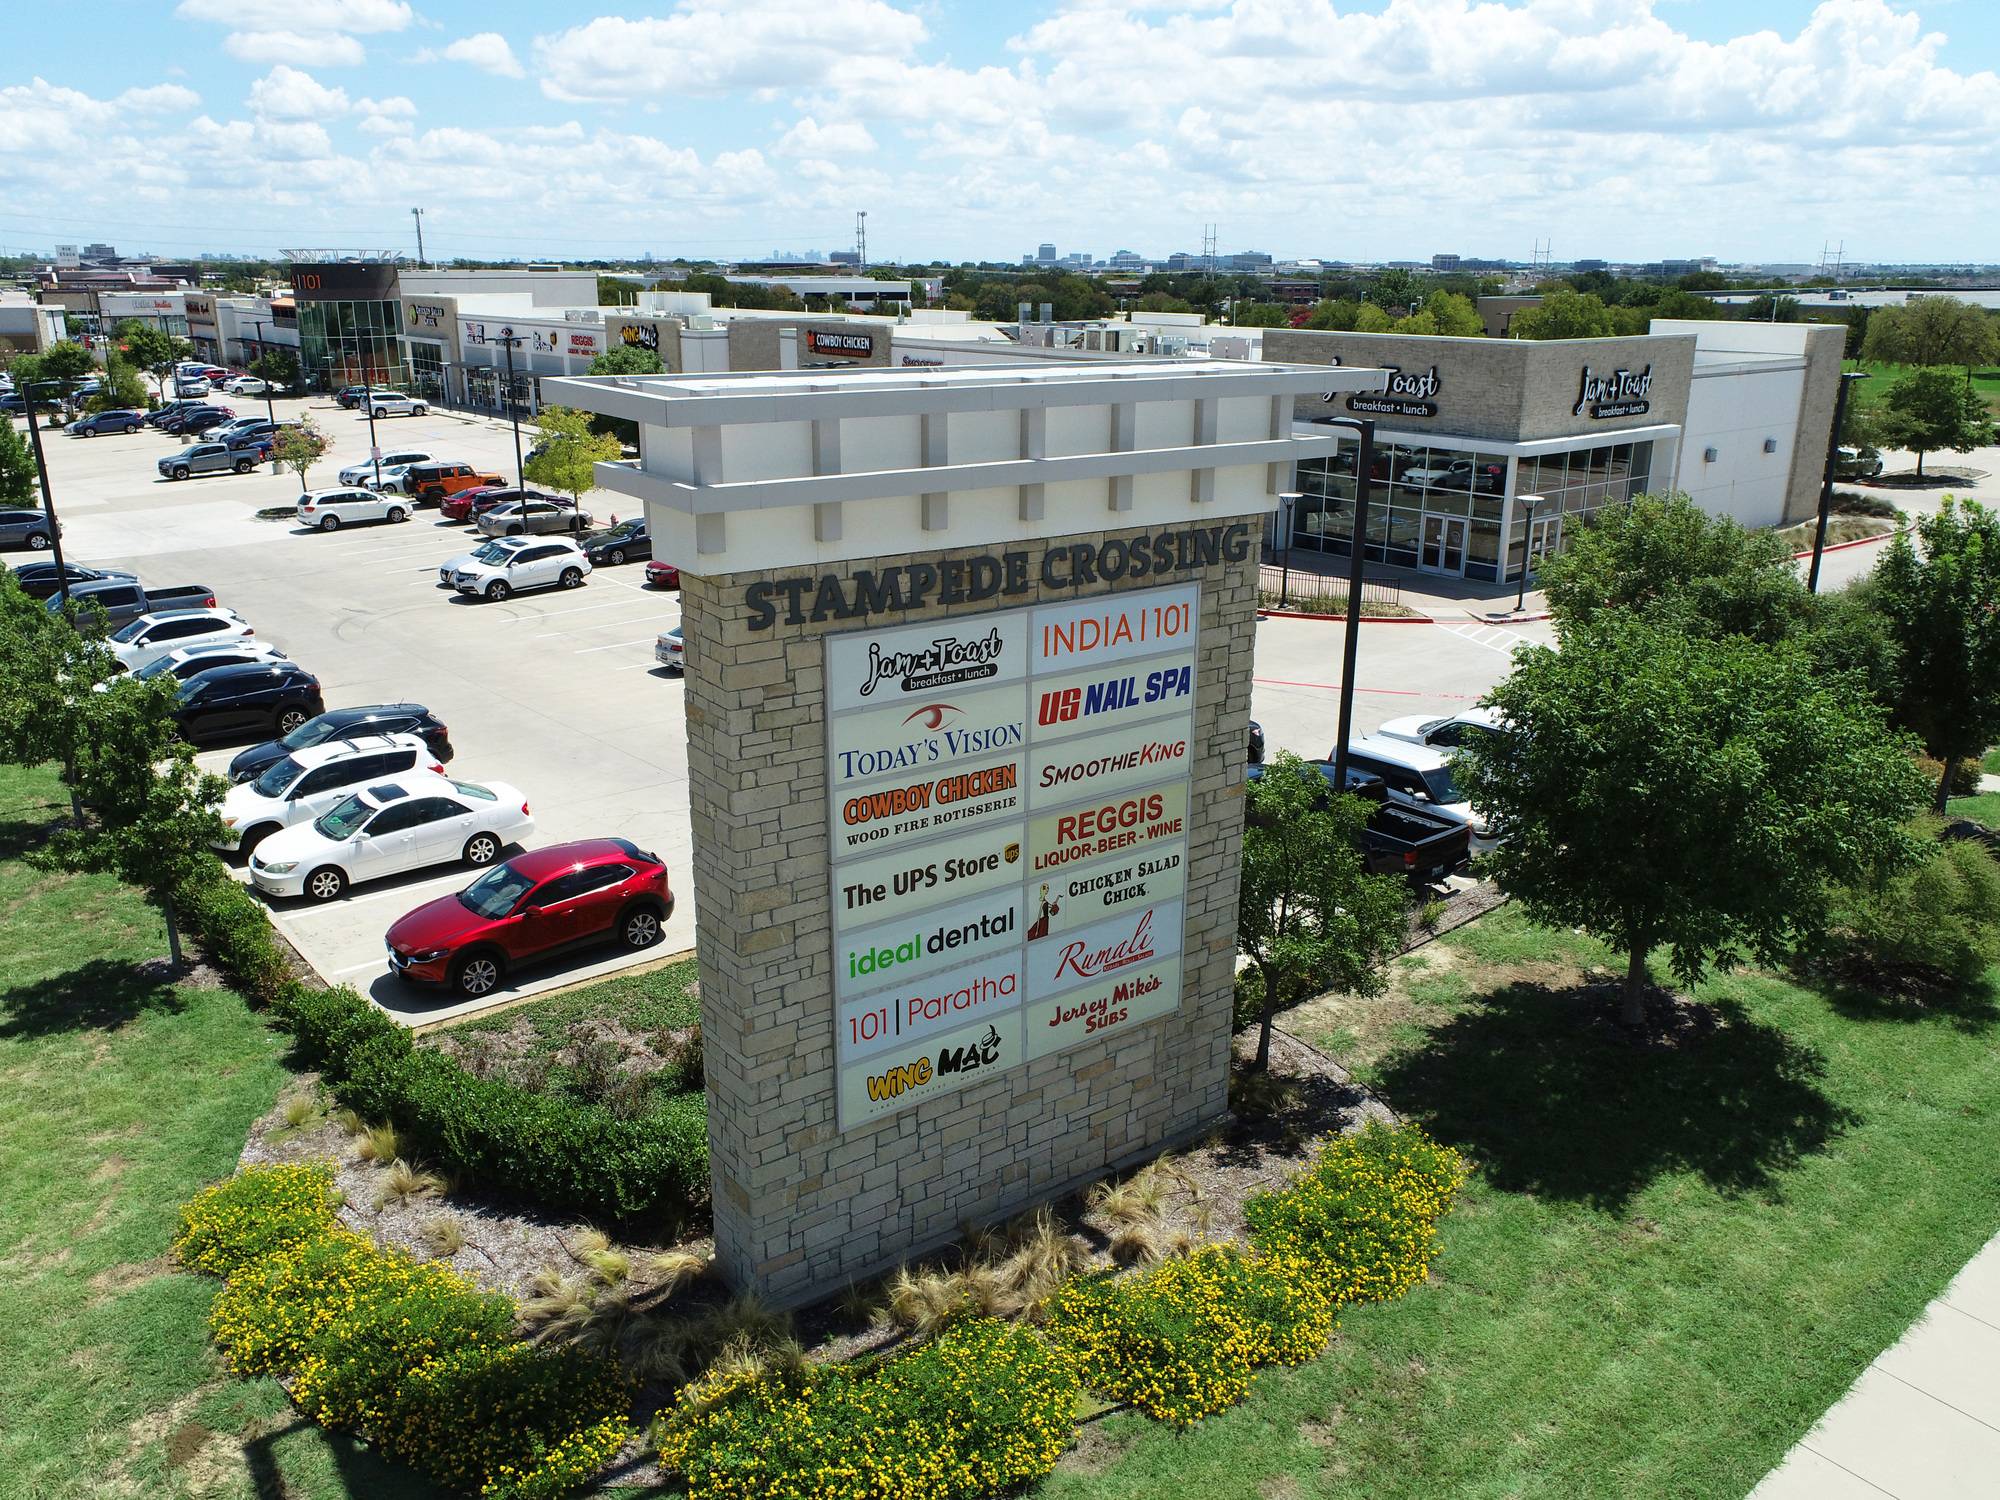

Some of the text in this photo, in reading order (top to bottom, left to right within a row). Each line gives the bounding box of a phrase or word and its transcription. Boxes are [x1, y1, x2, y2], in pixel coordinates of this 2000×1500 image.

[816, 334, 870, 350] COWBOY CHICKEN
[1353, 399, 1428, 416] breakfast lunch
[1598, 402, 1645, 417] breakfast lunch
[745, 523, 1250, 632] STAMPEDE CROSSING
[1043, 603, 1189, 657] INDIA 101
[910, 665, 990, 689] breakfast lunch
[1038, 665, 1191, 726] US NAIL SPA
[838, 722, 1023, 779] TODAY'S VISION
[843, 763, 1017, 825] COWBOY CHICKEN
[846, 796, 1017, 846] WOOD FIRE ROTISSERIE
[1056, 794, 1163, 845] REGGIS
[1147, 818, 1183, 839] WINE
[843, 848, 999, 910] The UPS Store
[1068, 854, 1181, 898] CHICKEN SALAD
[1102, 882, 1147, 906] CHICK
[849, 907, 1015, 978] ideal dental
[1054, 909, 1155, 981] Rumali
[849, 971, 1017, 1044] 101 Paratha
[1048, 973, 1163, 1029] Jersey Mike's
[1085, 1006, 1129, 1034] SUBS
[937, 1024, 1002, 1078] MAC
